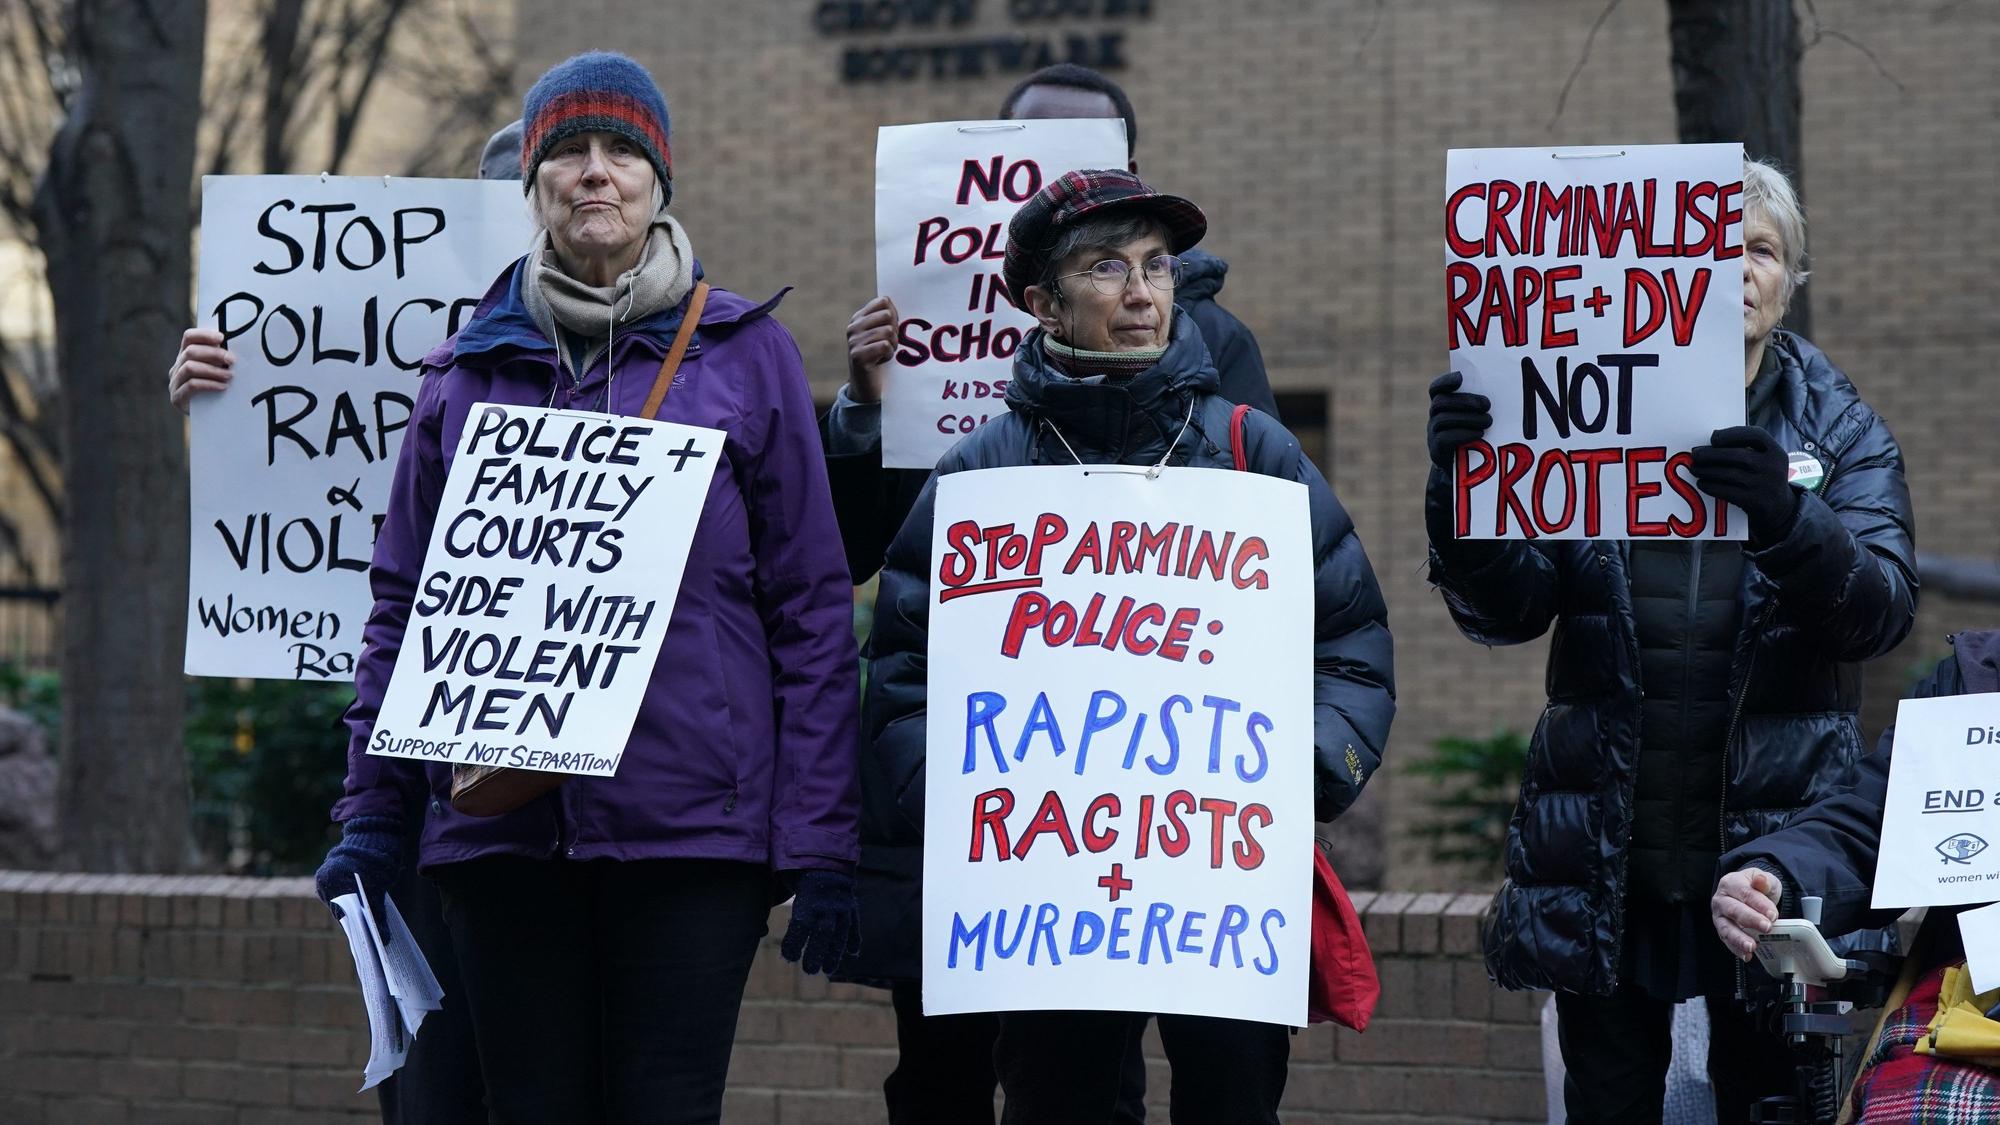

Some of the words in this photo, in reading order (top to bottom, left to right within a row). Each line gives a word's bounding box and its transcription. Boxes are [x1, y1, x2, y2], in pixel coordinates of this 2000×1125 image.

[956, 156, 1042, 205] NO
[253, 199, 445, 279] STOP
[1446, 179, 1743, 261] CRIMINALISE
[968, 273, 1019, 314] IN
[1446, 261, 1582, 349] RAPE
[1584, 286, 1612, 317] +
[1623, 268, 1712, 348] DV
[896, 318, 1036, 367] SCHO
[942, 379, 1008, 400] KIDS
[1521, 354, 1659, 440] NOT
[252, 386, 412, 466] RAP
[467, 407, 652, 466] POLICE
[667, 438, 705, 473] +
[466, 457, 654, 521] FAMILY
[215, 513, 386, 573] VIOL
[444, 509, 624, 573] COURTS
[940, 513, 1068, 587] STOP
[1063, 521, 1270, 590] ARMING
[199, 595, 340, 640] Women
[415, 571, 524, 618] SIDE
[544, 584, 655, 640] WITH
[1000, 590, 1224, 665] POLICE:
[422, 626, 641, 689] VIOLENT
[419, 680, 575, 738] MEN
[962, 690, 1274, 783] RAPISTS
[371, 729, 461, 759] SUPPORT
[465, 742, 508, 764] NOT
[508, 745, 620, 771] SEPARATION
[968, 788, 1273, 870] RACISTS
[1924, 789, 1985, 810] END
[1098, 863, 1132, 901] +
[1938, 873, 1982, 884] women
[947, 902, 1286, 976] MURDERERS
